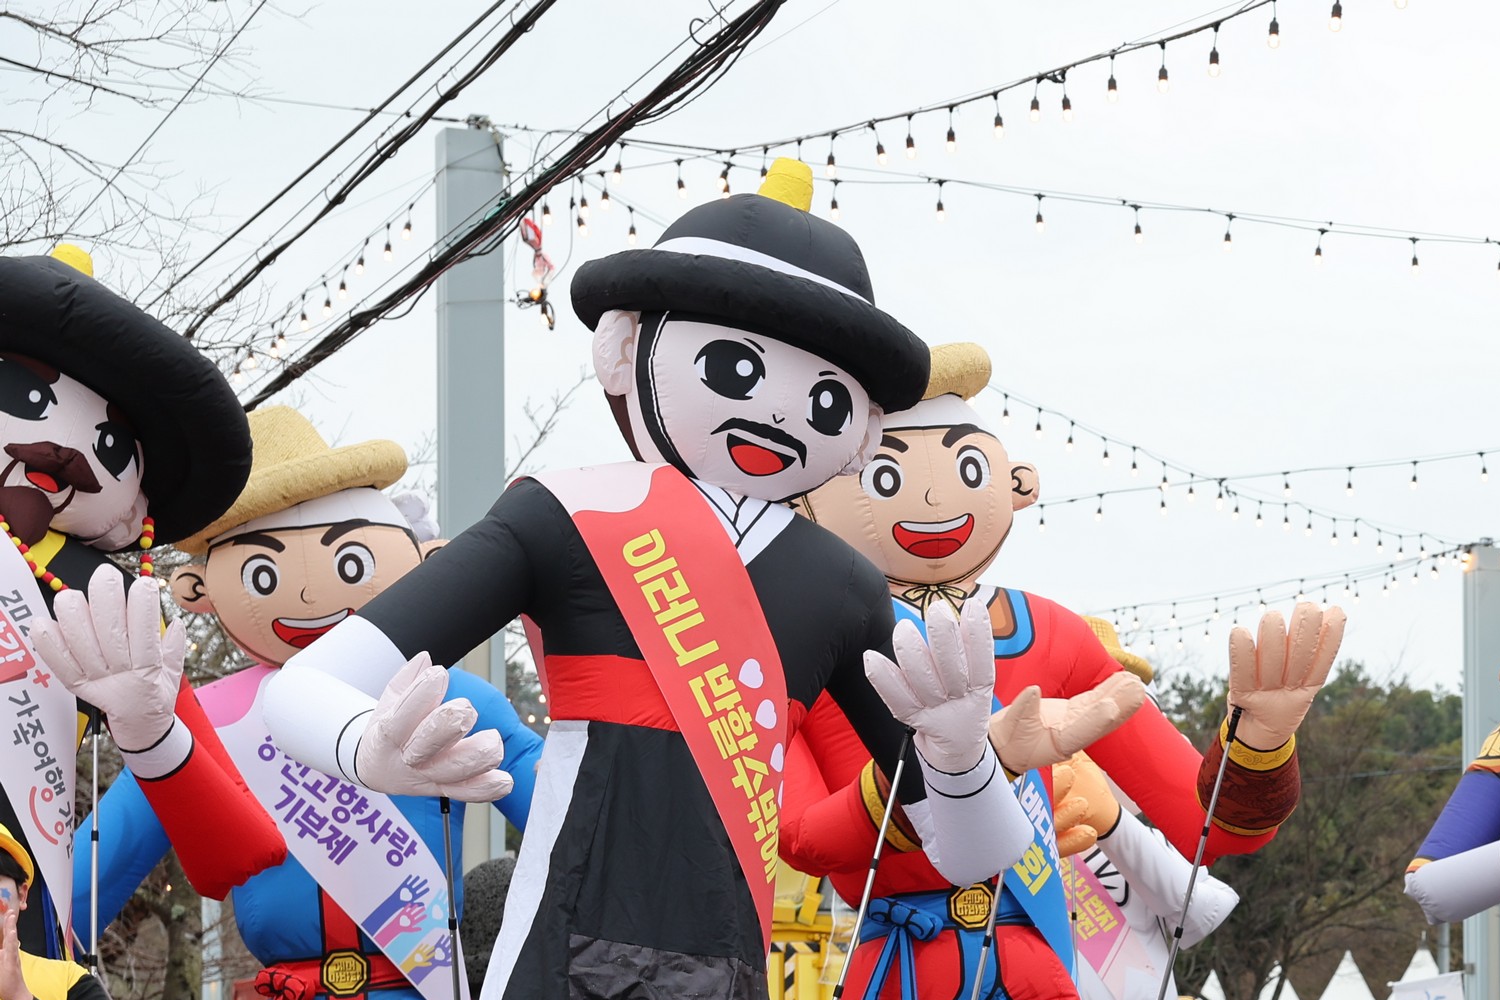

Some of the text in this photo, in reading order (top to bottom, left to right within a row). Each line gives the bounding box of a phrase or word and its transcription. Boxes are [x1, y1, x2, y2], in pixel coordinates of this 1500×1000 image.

[622, 528, 720, 668] 이러니
[8, 689, 67, 803] 가족여행
[274, 784, 358, 866] 기부제
